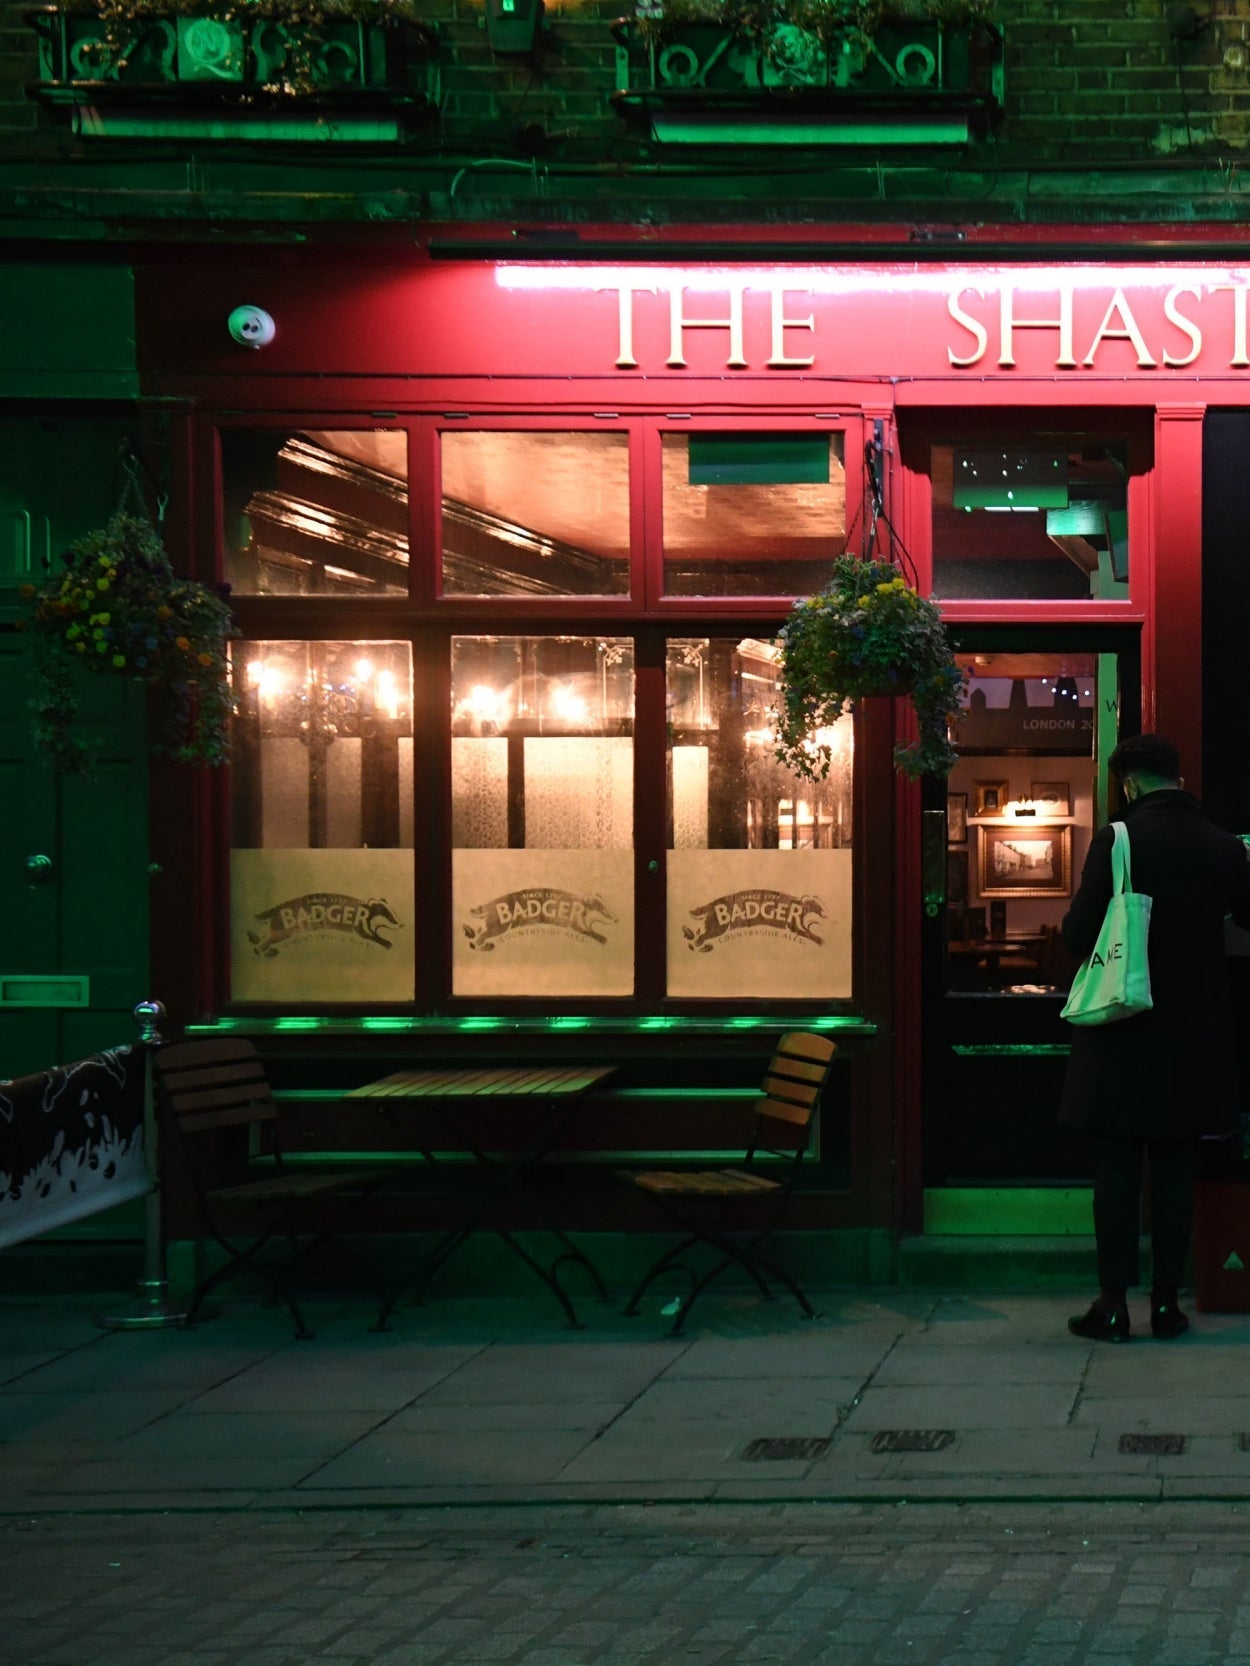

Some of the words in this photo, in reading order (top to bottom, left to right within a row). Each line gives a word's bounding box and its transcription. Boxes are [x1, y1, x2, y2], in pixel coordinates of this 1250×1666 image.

[594, 284, 814, 367] THE
[1023, 719, 1075, 730] LONDON
[279, 904, 372, 931] BADGER
[495, 899, 586, 926] BADGER
[714, 900, 804, 927] BADGER
